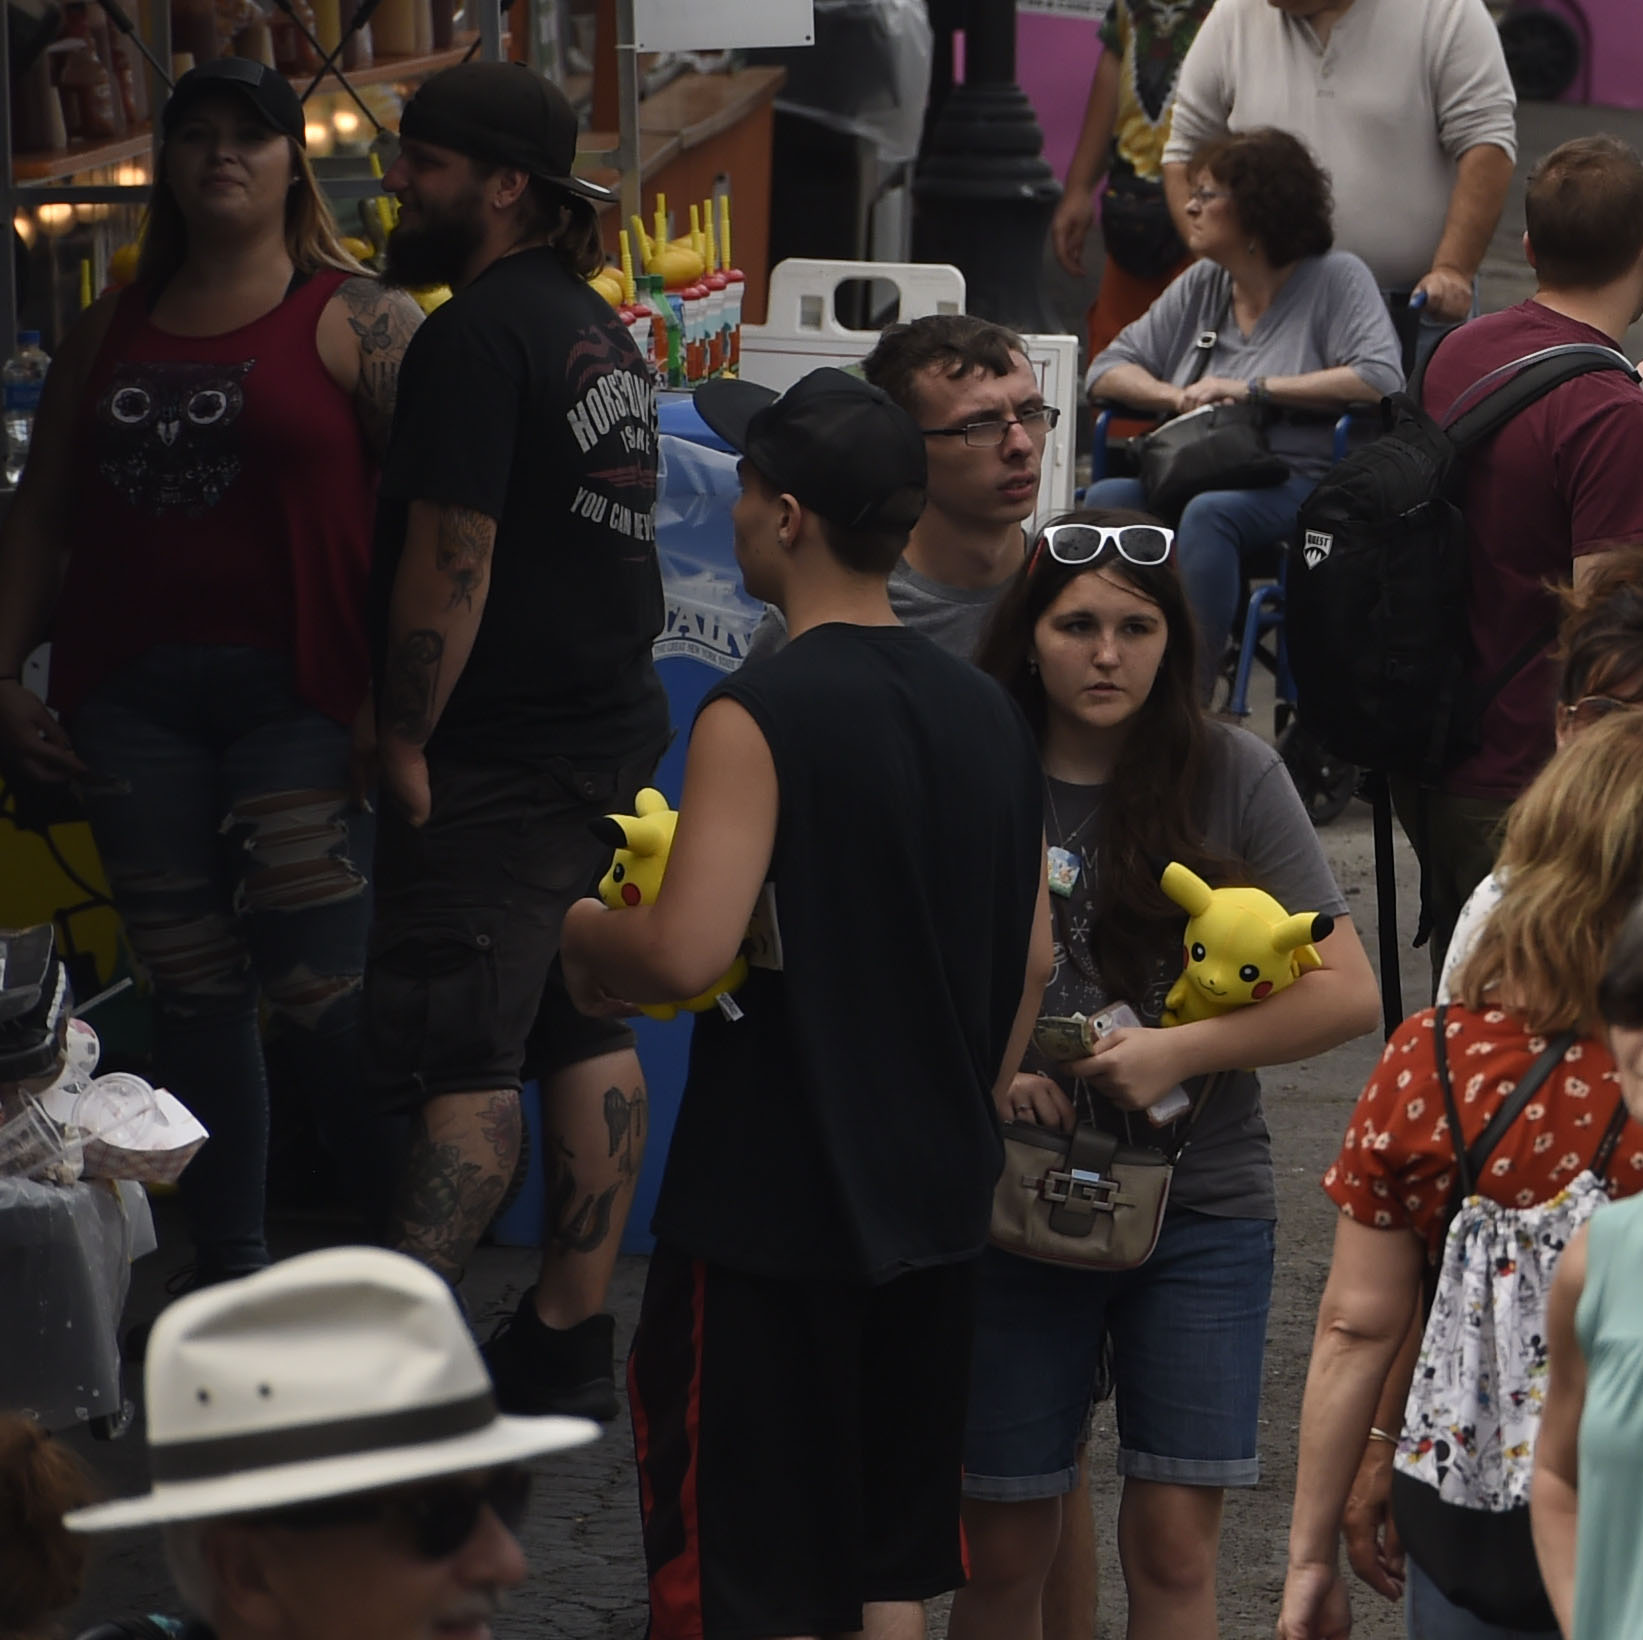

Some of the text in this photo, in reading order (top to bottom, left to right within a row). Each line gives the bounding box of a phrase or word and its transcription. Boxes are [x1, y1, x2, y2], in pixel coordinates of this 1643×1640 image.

[567, 367, 656, 454] HORSPOW
[571, 485, 607, 524] YOU
[609, 502, 633, 537] CAN
[1307, 533, 1330, 547] QUEST
